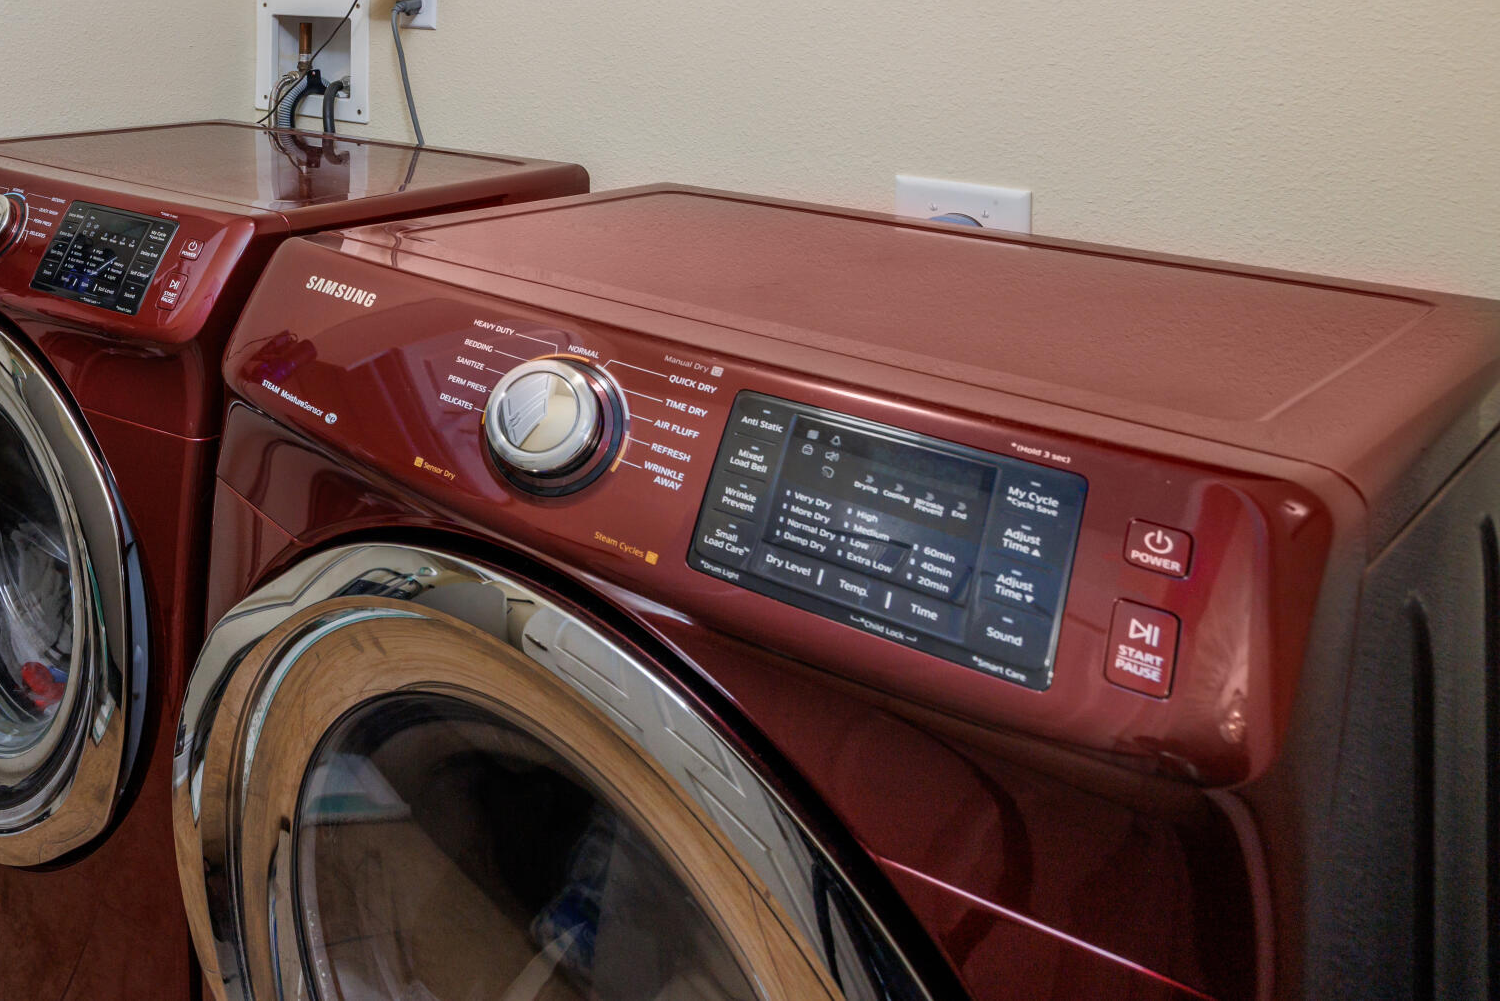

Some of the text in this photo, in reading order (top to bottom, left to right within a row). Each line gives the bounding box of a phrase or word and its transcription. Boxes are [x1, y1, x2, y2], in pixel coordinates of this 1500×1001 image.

[181, 250, 197, 258] POWER
[161, 296, 174, 304] PAUSE
[163, 290, 177, 298] START
[305, 275, 377, 308] SAMSUNG
[473, 319, 515, 336] HEAVY DUTY
[464, 338, 494, 353] BEDDING
[568, 344, 600, 359] NORMAL
[456, 356, 485, 371] SANITIZE
[664, 355, 709, 373] Manual Dry
[448, 374, 487, 393] PERM PRESS
[669, 375, 718, 394] QUICK DRY
[262, 379, 324, 417] STEAM MoistureSensor
[440, 392, 473, 411] DELICATES
[665, 398, 708, 418] TIME DRY
[653, 419, 700, 439] AIR FLUFF
[741, 415, 784, 433] Anti Static
[651, 443, 691, 463] REFRESH
[738, 449, 764, 462] Mixed
[1043, 450, 1050, 459] 3
[423, 461, 456, 481] Sensor Dry
[644, 461, 684, 482] WRINKLE
[729, 456, 767, 474] Load Bell
[653, 476, 682, 491] AWAY
[853, 481, 911, 504] Drying Cooling
[725, 486, 757, 503] Wrinkle
[794, 491, 832, 510] Very Dry
[1007, 486, 1059, 508] My Cycle
[721, 496, 754, 513] Prevent
[1035, 503, 1059, 517] Save
[790, 505, 831, 524] More Dry
[856, 510, 879, 524] High
[951, 510, 968, 520] End
[715, 529, 739, 543] Small
[787, 519, 836, 541] Normal Dry
[853, 524, 890, 542] Medium
[1003, 528, 1041, 546] Adjust
[594, 531, 644, 558] Steam Cycles
[704, 535, 724, 549] Load
[783, 532, 827, 553] Damp Dry
[849, 538, 870, 551] Low
[1002, 538, 1030, 554] Time
[846, 552, 893, 574] Extra Low
[924, 546, 956, 564] 60min
[1130, 549, 1181, 572] POWER
[722, 567, 739, 581] Light
[766, 554, 812, 577] Dry Level
[920, 561, 952, 578] 40min
[839, 579, 868, 598] Temp.
[917, 576, 949, 594] 20min
[994, 584, 1023, 601] Time
[996, 574, 1034, 593] Adjust
[910, 603, 939, 621] Time
[885, 626, 904, 640] Lock
[985, 627, 1023, 647] Sound
[1118, 644, 1164, 667] START
[1005, 669, 1027, 683] Care
[1114, 658, 1162, 682] PAUSE
